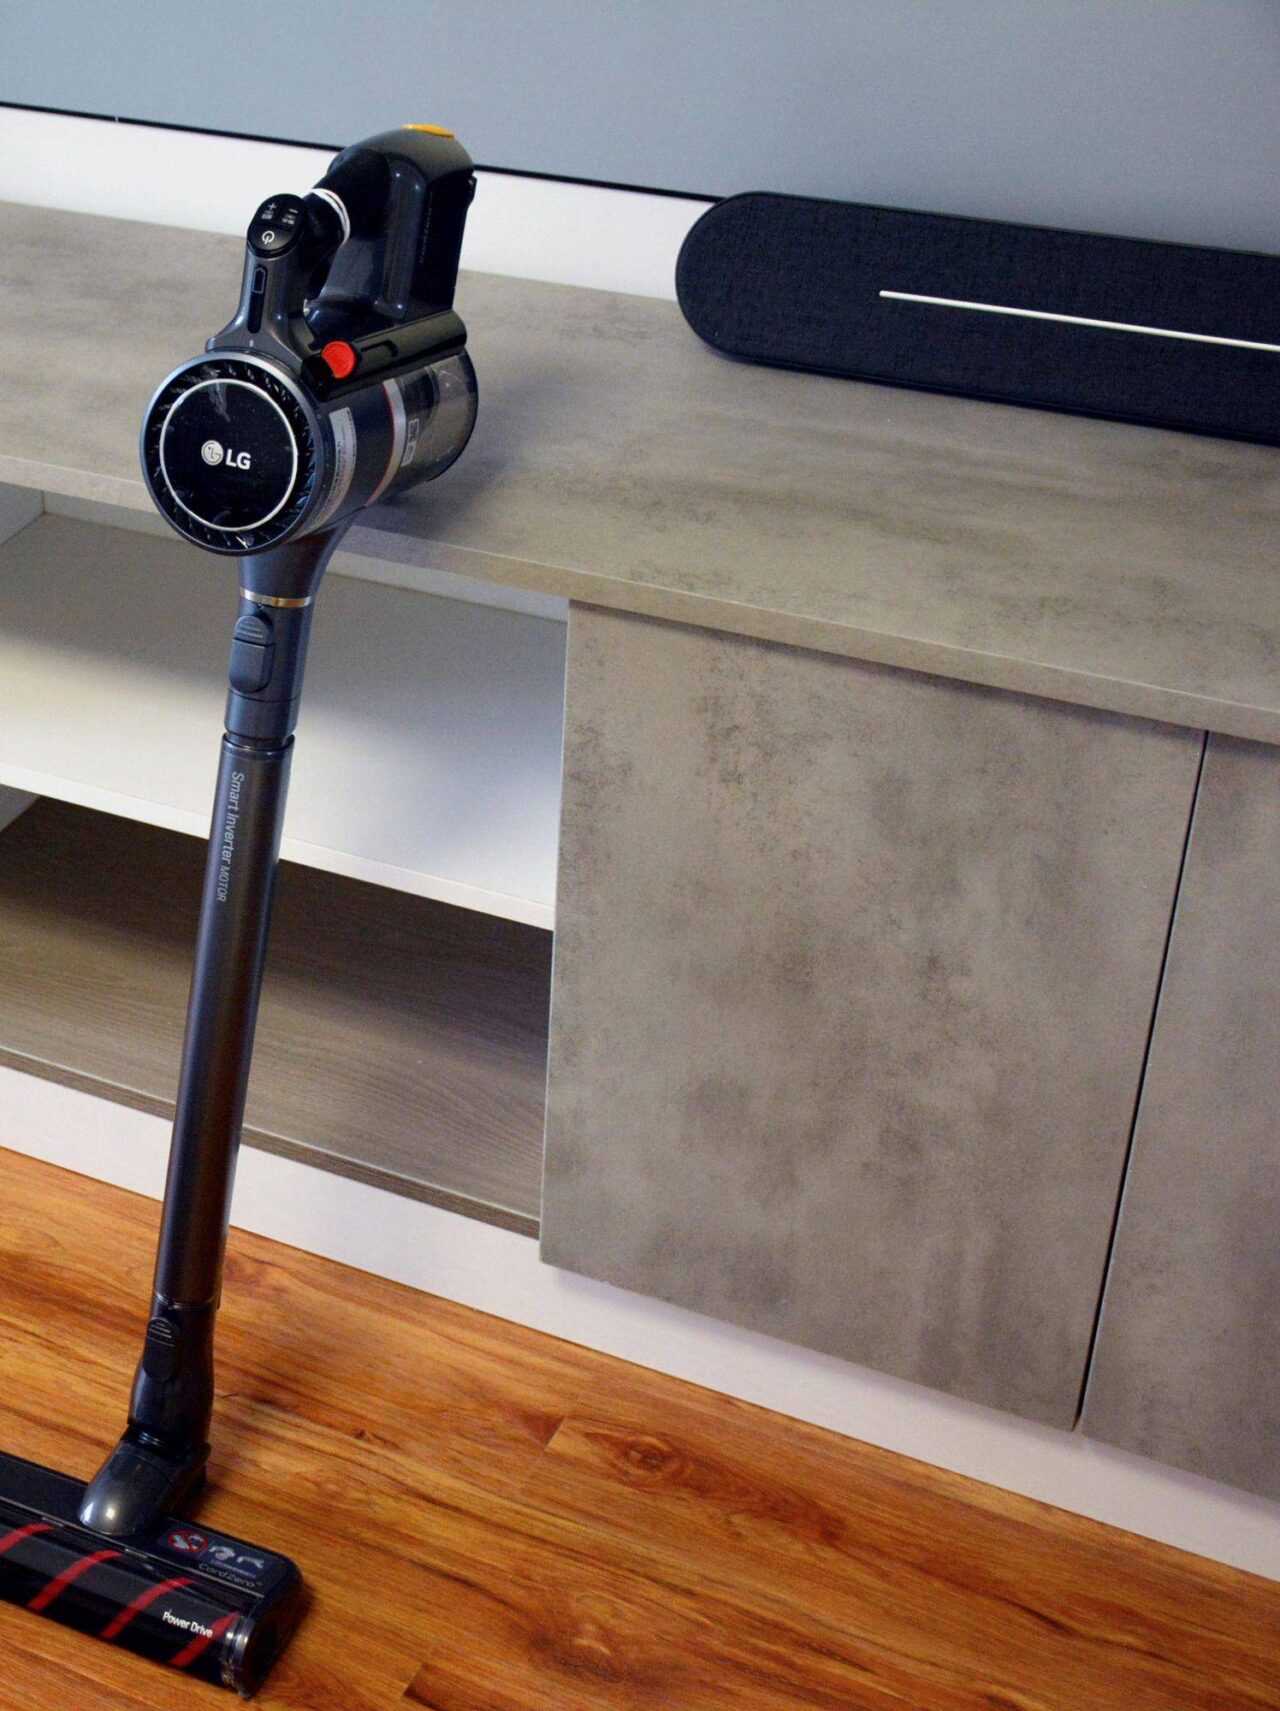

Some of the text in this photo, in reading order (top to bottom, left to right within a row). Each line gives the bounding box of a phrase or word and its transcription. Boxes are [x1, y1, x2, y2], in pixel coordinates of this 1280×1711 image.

[225, 448, 251, 470] LG
[216, 771, 244, 902] Smart Inverter MOTOR
[162, 1610, 213, 1638] Power Drive
